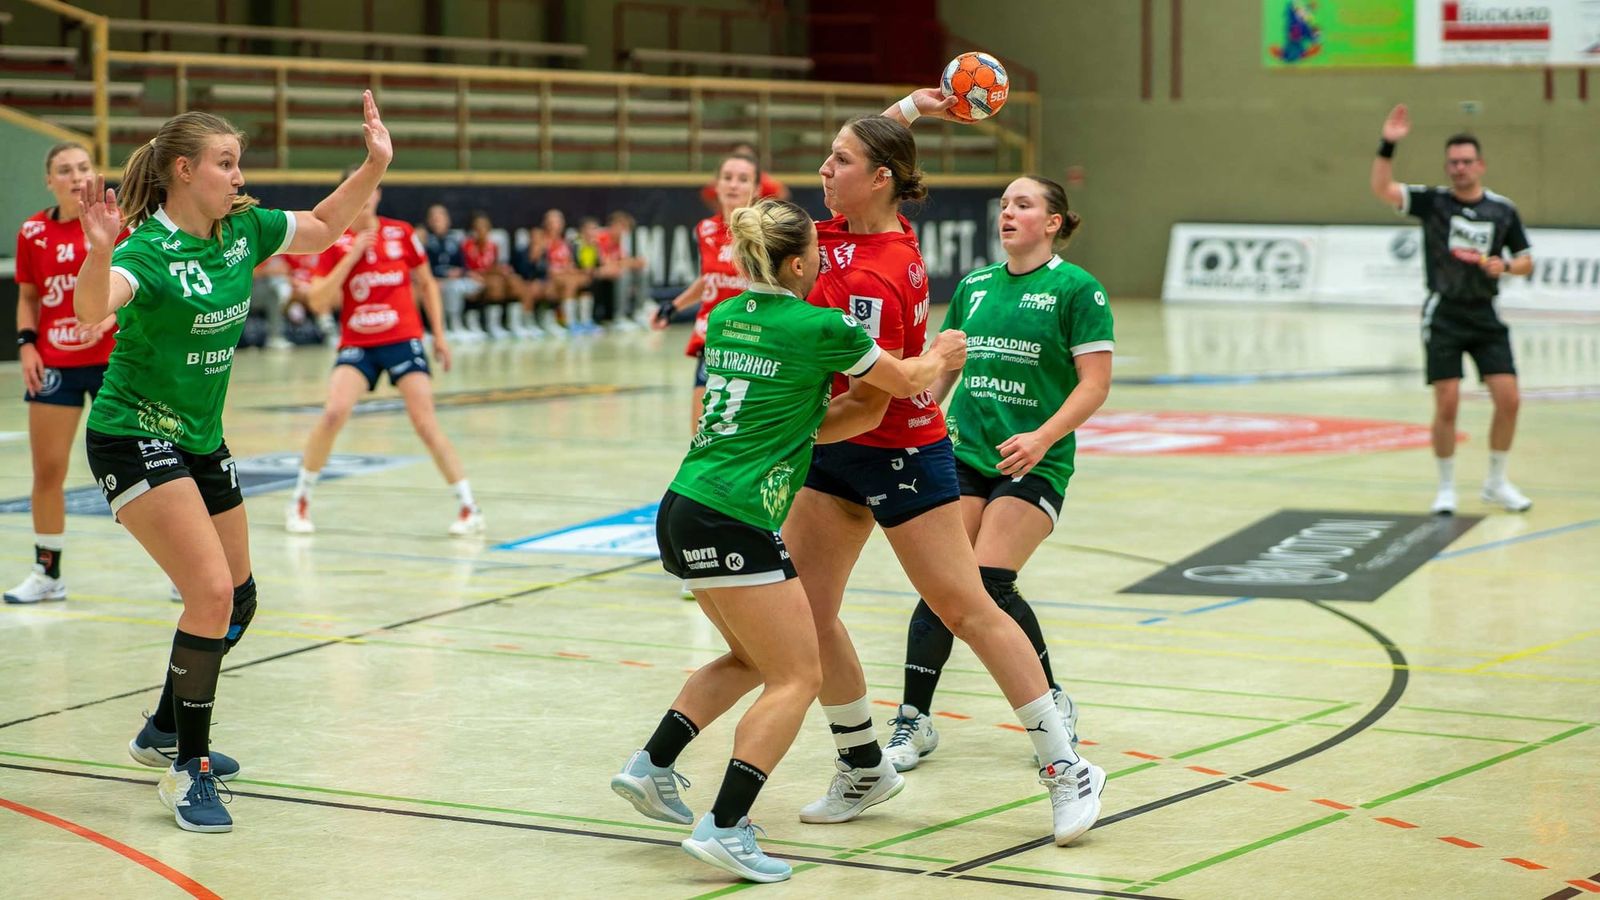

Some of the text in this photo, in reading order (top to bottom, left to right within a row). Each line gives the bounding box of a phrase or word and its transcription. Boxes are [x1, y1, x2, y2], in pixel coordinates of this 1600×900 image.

[56, 243, 75, 263] 24
[168, 260, 213, 298] 73
[966, 289, 988, 321] 7
[722, 350, 782, 378] KIRCHHOF
[1001, 353, 1039, 367] Immobilien
[997, 394, 1039, 408] EXPERTISE
[144, 456, 179, 471] Kempa
[682, 546, 718, 562] horn
